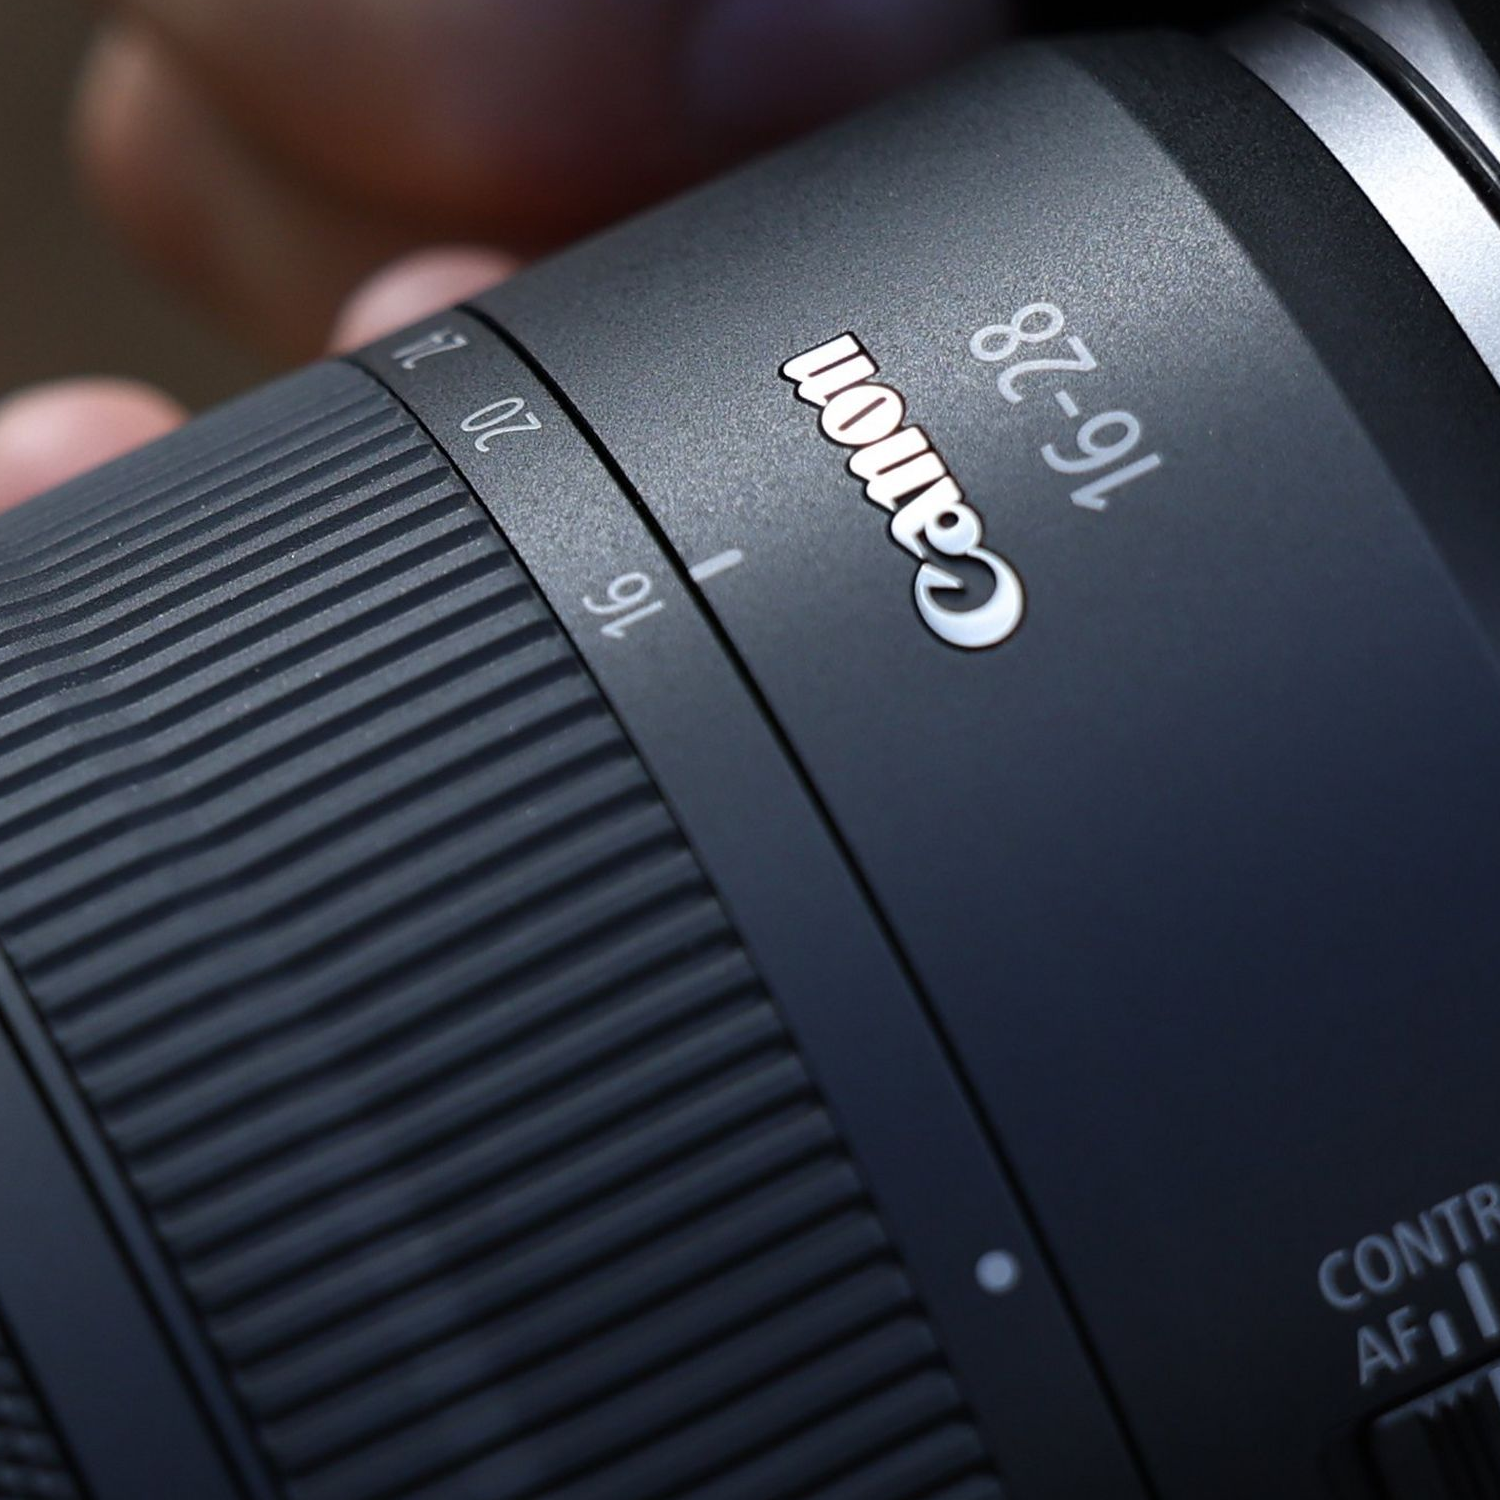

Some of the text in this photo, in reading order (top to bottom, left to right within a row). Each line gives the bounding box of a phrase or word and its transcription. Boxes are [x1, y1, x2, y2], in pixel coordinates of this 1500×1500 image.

[460, 396, 542, 452] 20
[969, 301, 1162, 512] 16-28
[780, 330, 1027, 651] Canon
[581, 572, 663, 639] 16
[1356, 1304, 1425, 1387] AF
